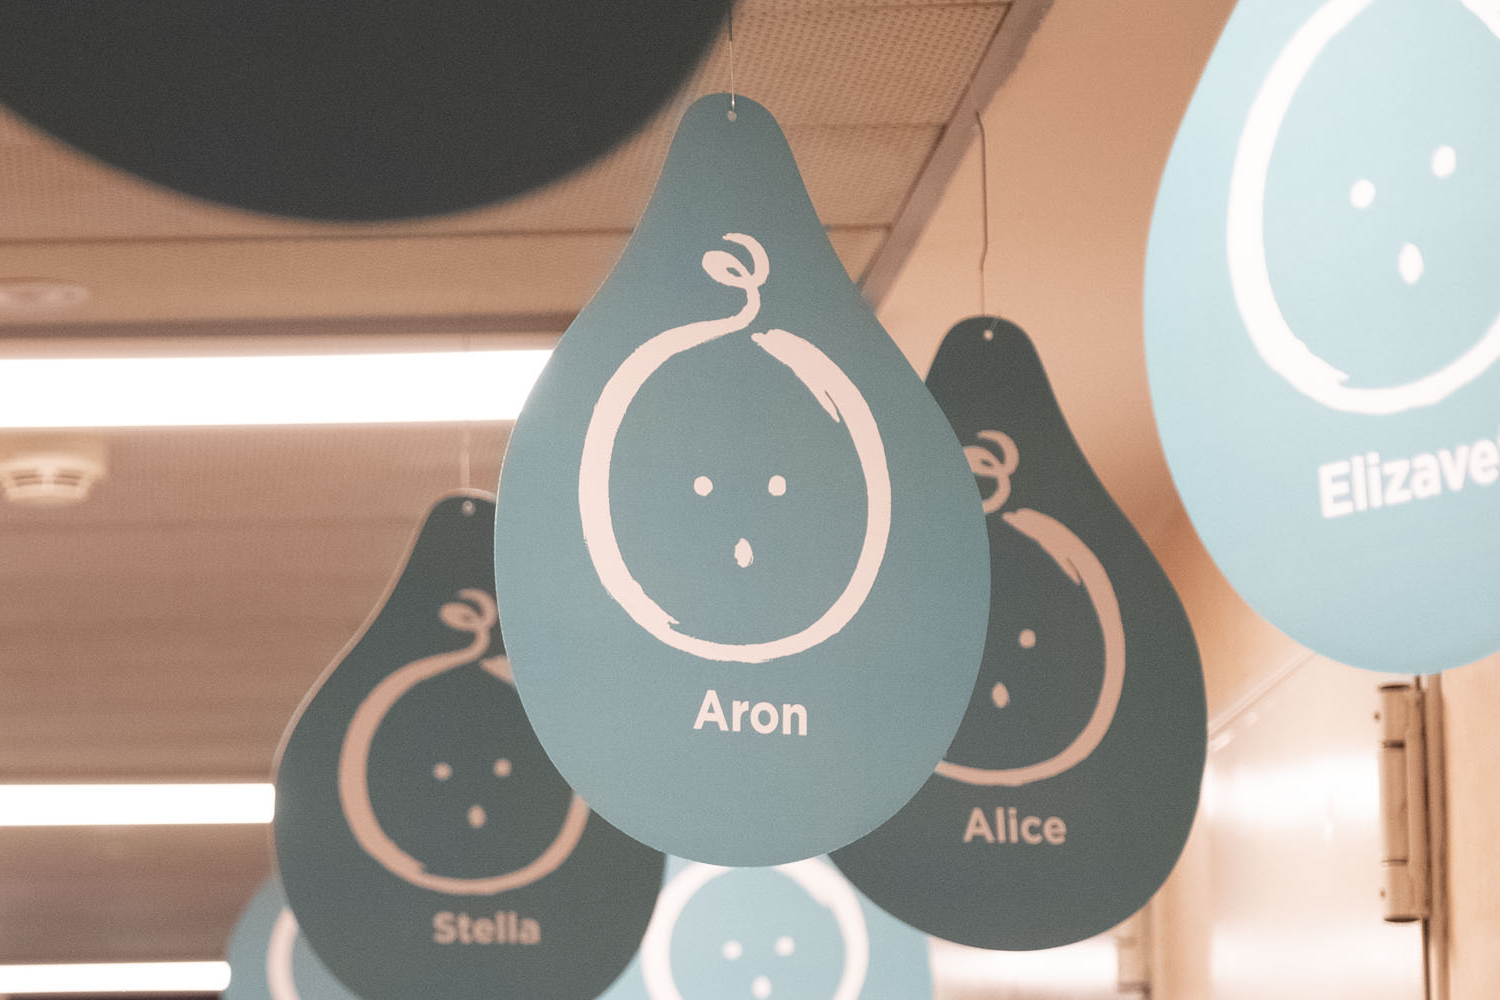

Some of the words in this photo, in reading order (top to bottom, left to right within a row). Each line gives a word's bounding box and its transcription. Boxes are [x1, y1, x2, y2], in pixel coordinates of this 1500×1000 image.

[1318, 426, 1500, 519] Elizave
[692, 689, 808, 736] Aron
[963, 806, 1068, 846] Alice
[432, 910, 541, 945] Stella
